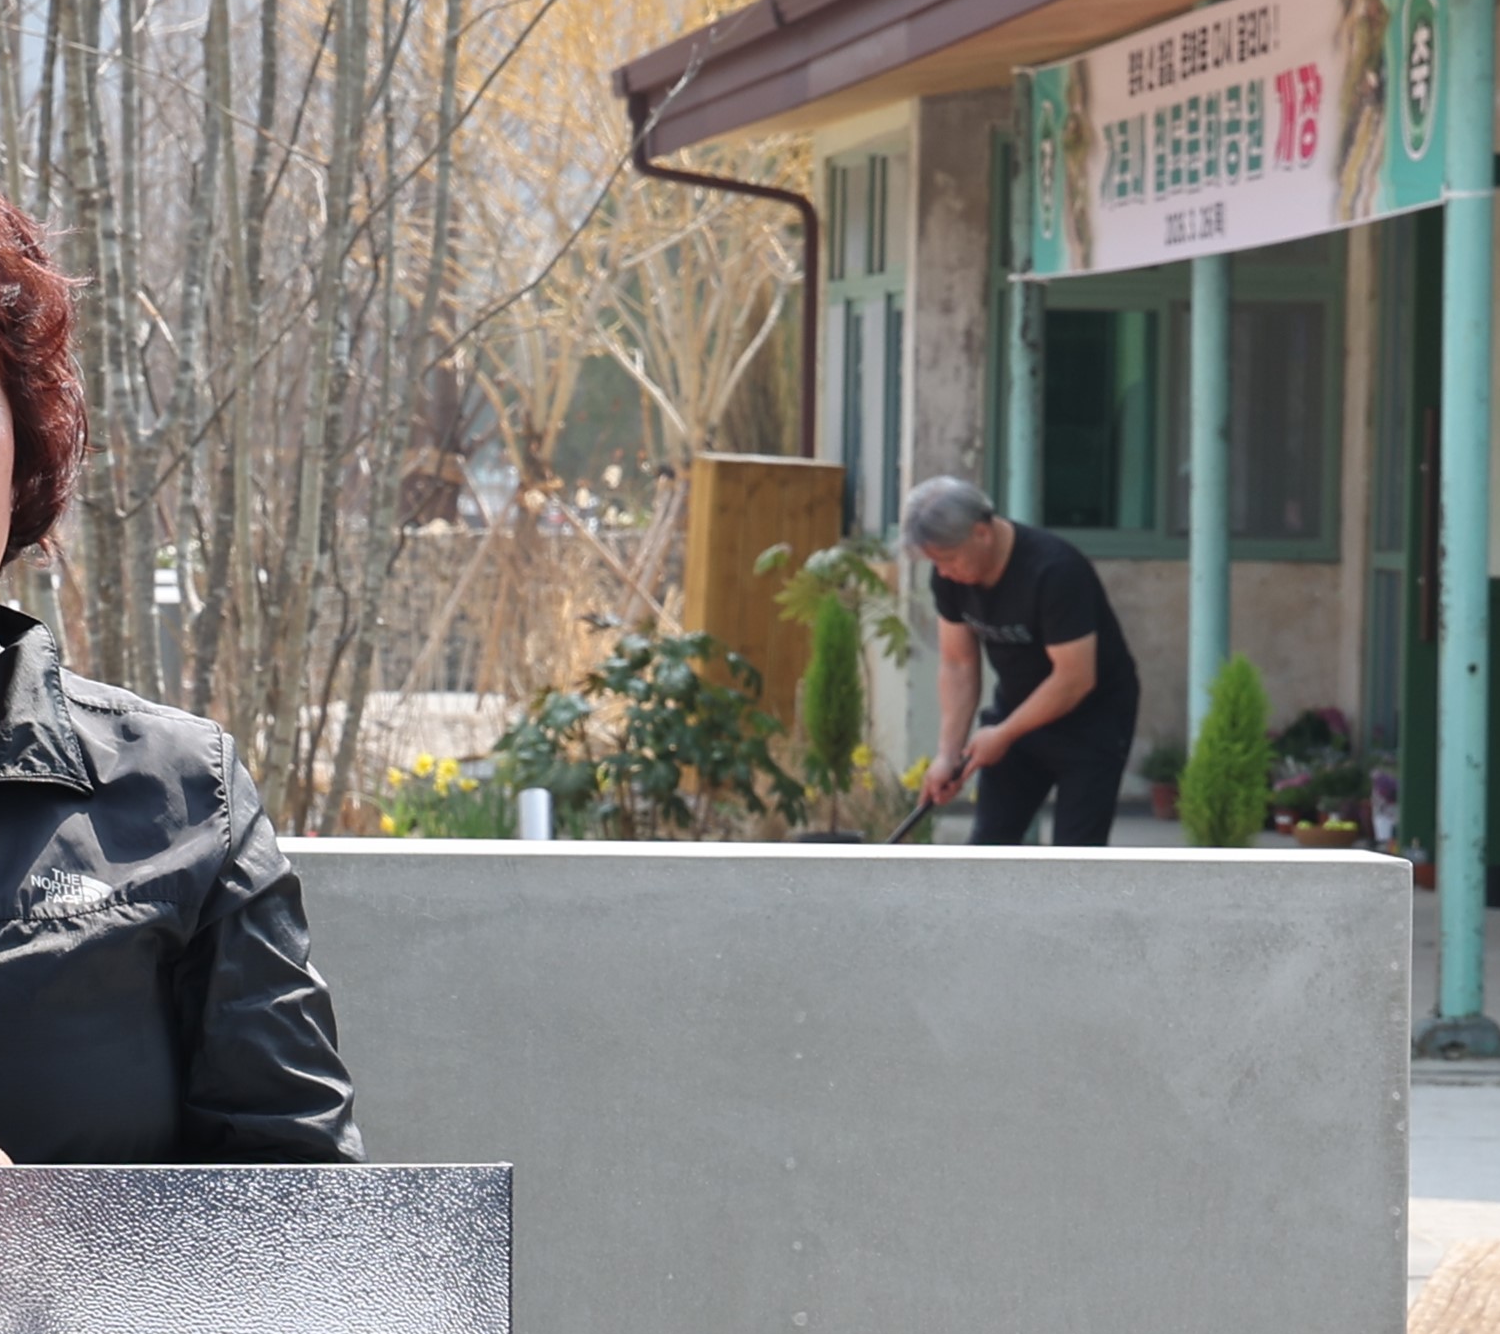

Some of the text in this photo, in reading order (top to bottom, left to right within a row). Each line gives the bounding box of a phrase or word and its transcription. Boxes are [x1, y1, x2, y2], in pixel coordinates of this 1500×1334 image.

[1212, 17, 1232, 67] 다시
[1155, 77, 1265, 197] 철도문화공원
[1275, 61, 1323, 166] 개장
[31, 874, 82, 896] NORTH
[51, 867, 80, 885] THE
[45, 891, 83, 905] FACE
